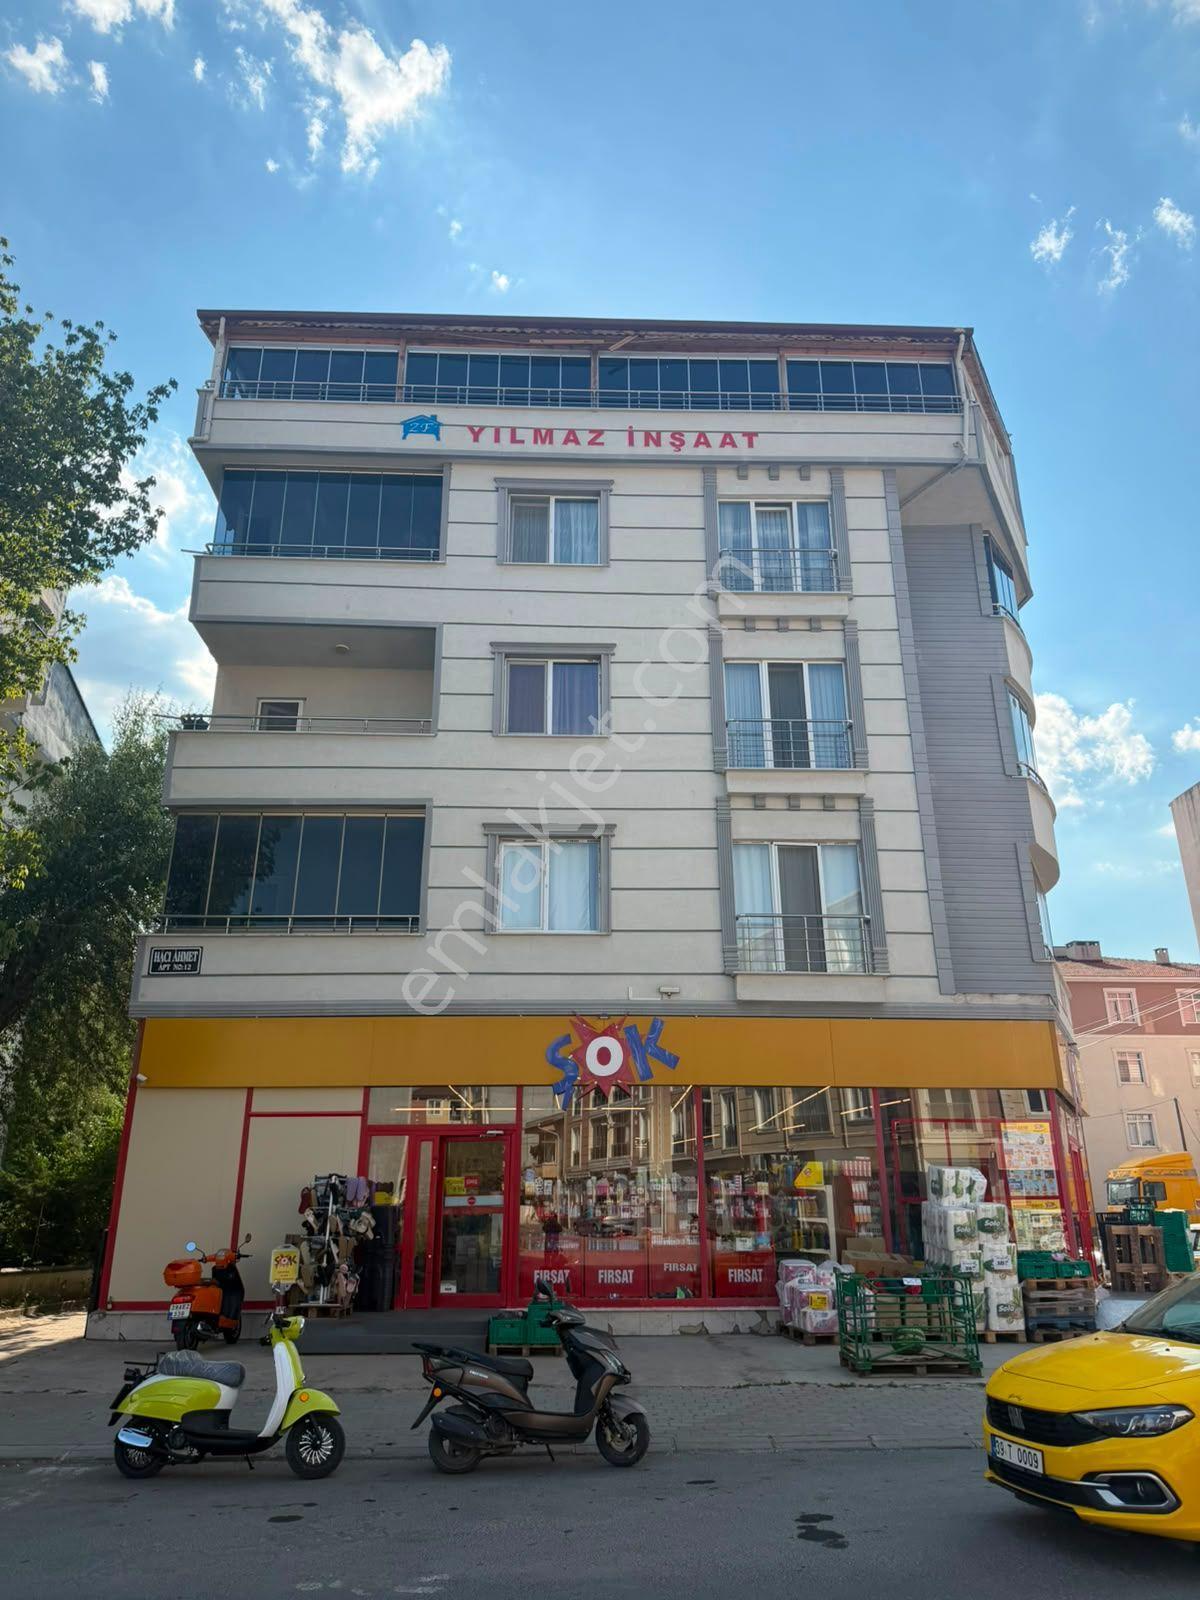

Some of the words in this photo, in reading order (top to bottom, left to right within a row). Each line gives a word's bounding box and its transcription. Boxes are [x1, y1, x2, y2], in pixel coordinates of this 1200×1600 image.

[467, 425, 605, 447] YILMAZ
[627, 425, 759, 452] İNŞAAT
[545, 1016, 681, 1111] ŞOK
[598, 1269, 634, 1284] FIRSAT
[663, 1262, 698, 1272] FIRSAT
[728, 1268, 763, 1283] FIRSAT
[995, 1440, 1005, 1457] 39
[1007, 1443, 1012, 1461] T
[1017, 1447, 1039, 1469] 0009
